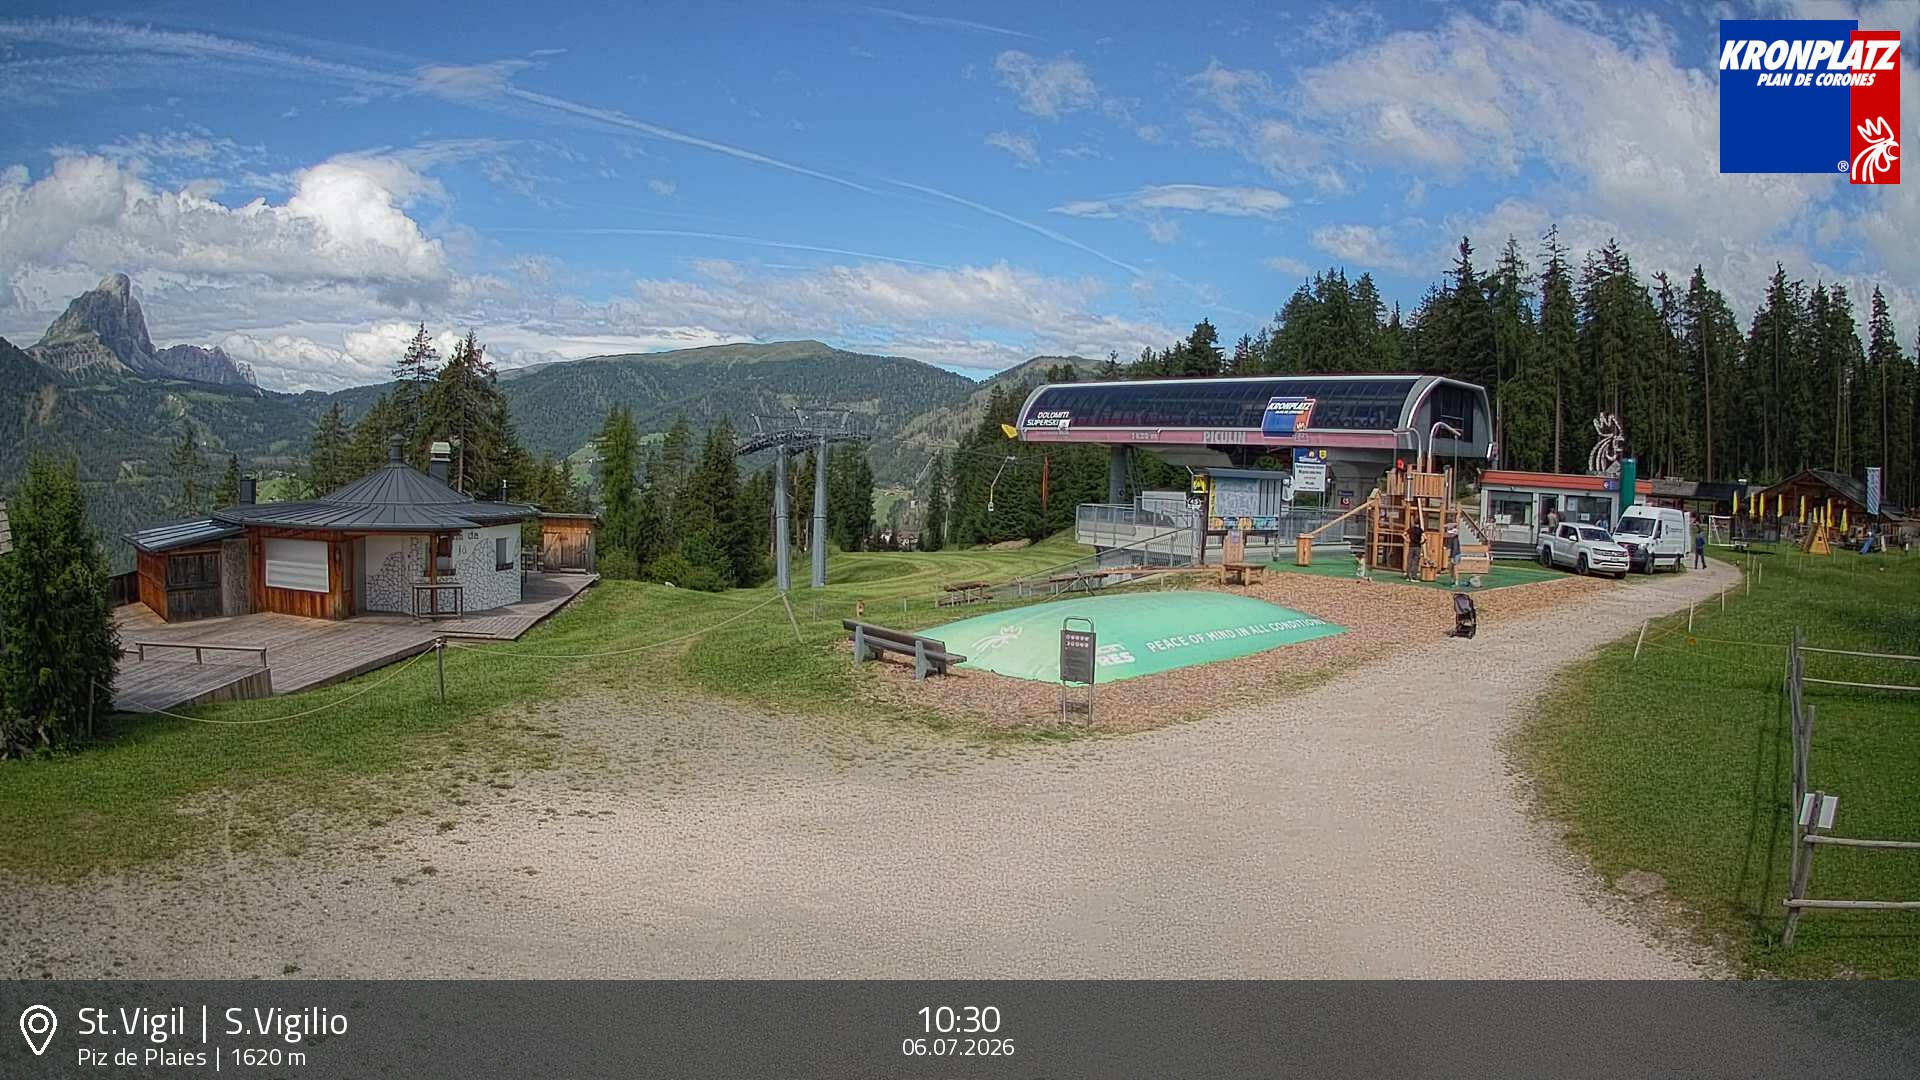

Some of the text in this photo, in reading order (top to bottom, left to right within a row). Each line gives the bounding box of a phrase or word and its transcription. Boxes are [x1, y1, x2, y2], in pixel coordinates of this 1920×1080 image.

[1037, 411, 1070, 419] DOLOMITI
[1026, 419, 1059, 427] SUPERSKI
[1203, 431, 1246, 444] PICULIN
[1145, 635, 1189, 653] PEACE
[1188, 632, 1206, 644] OF
[1206, 628, 1236, 642] MIND
[1236, 626, 1250, 637] IN
[1249, 624, 1270, 635] ALL
